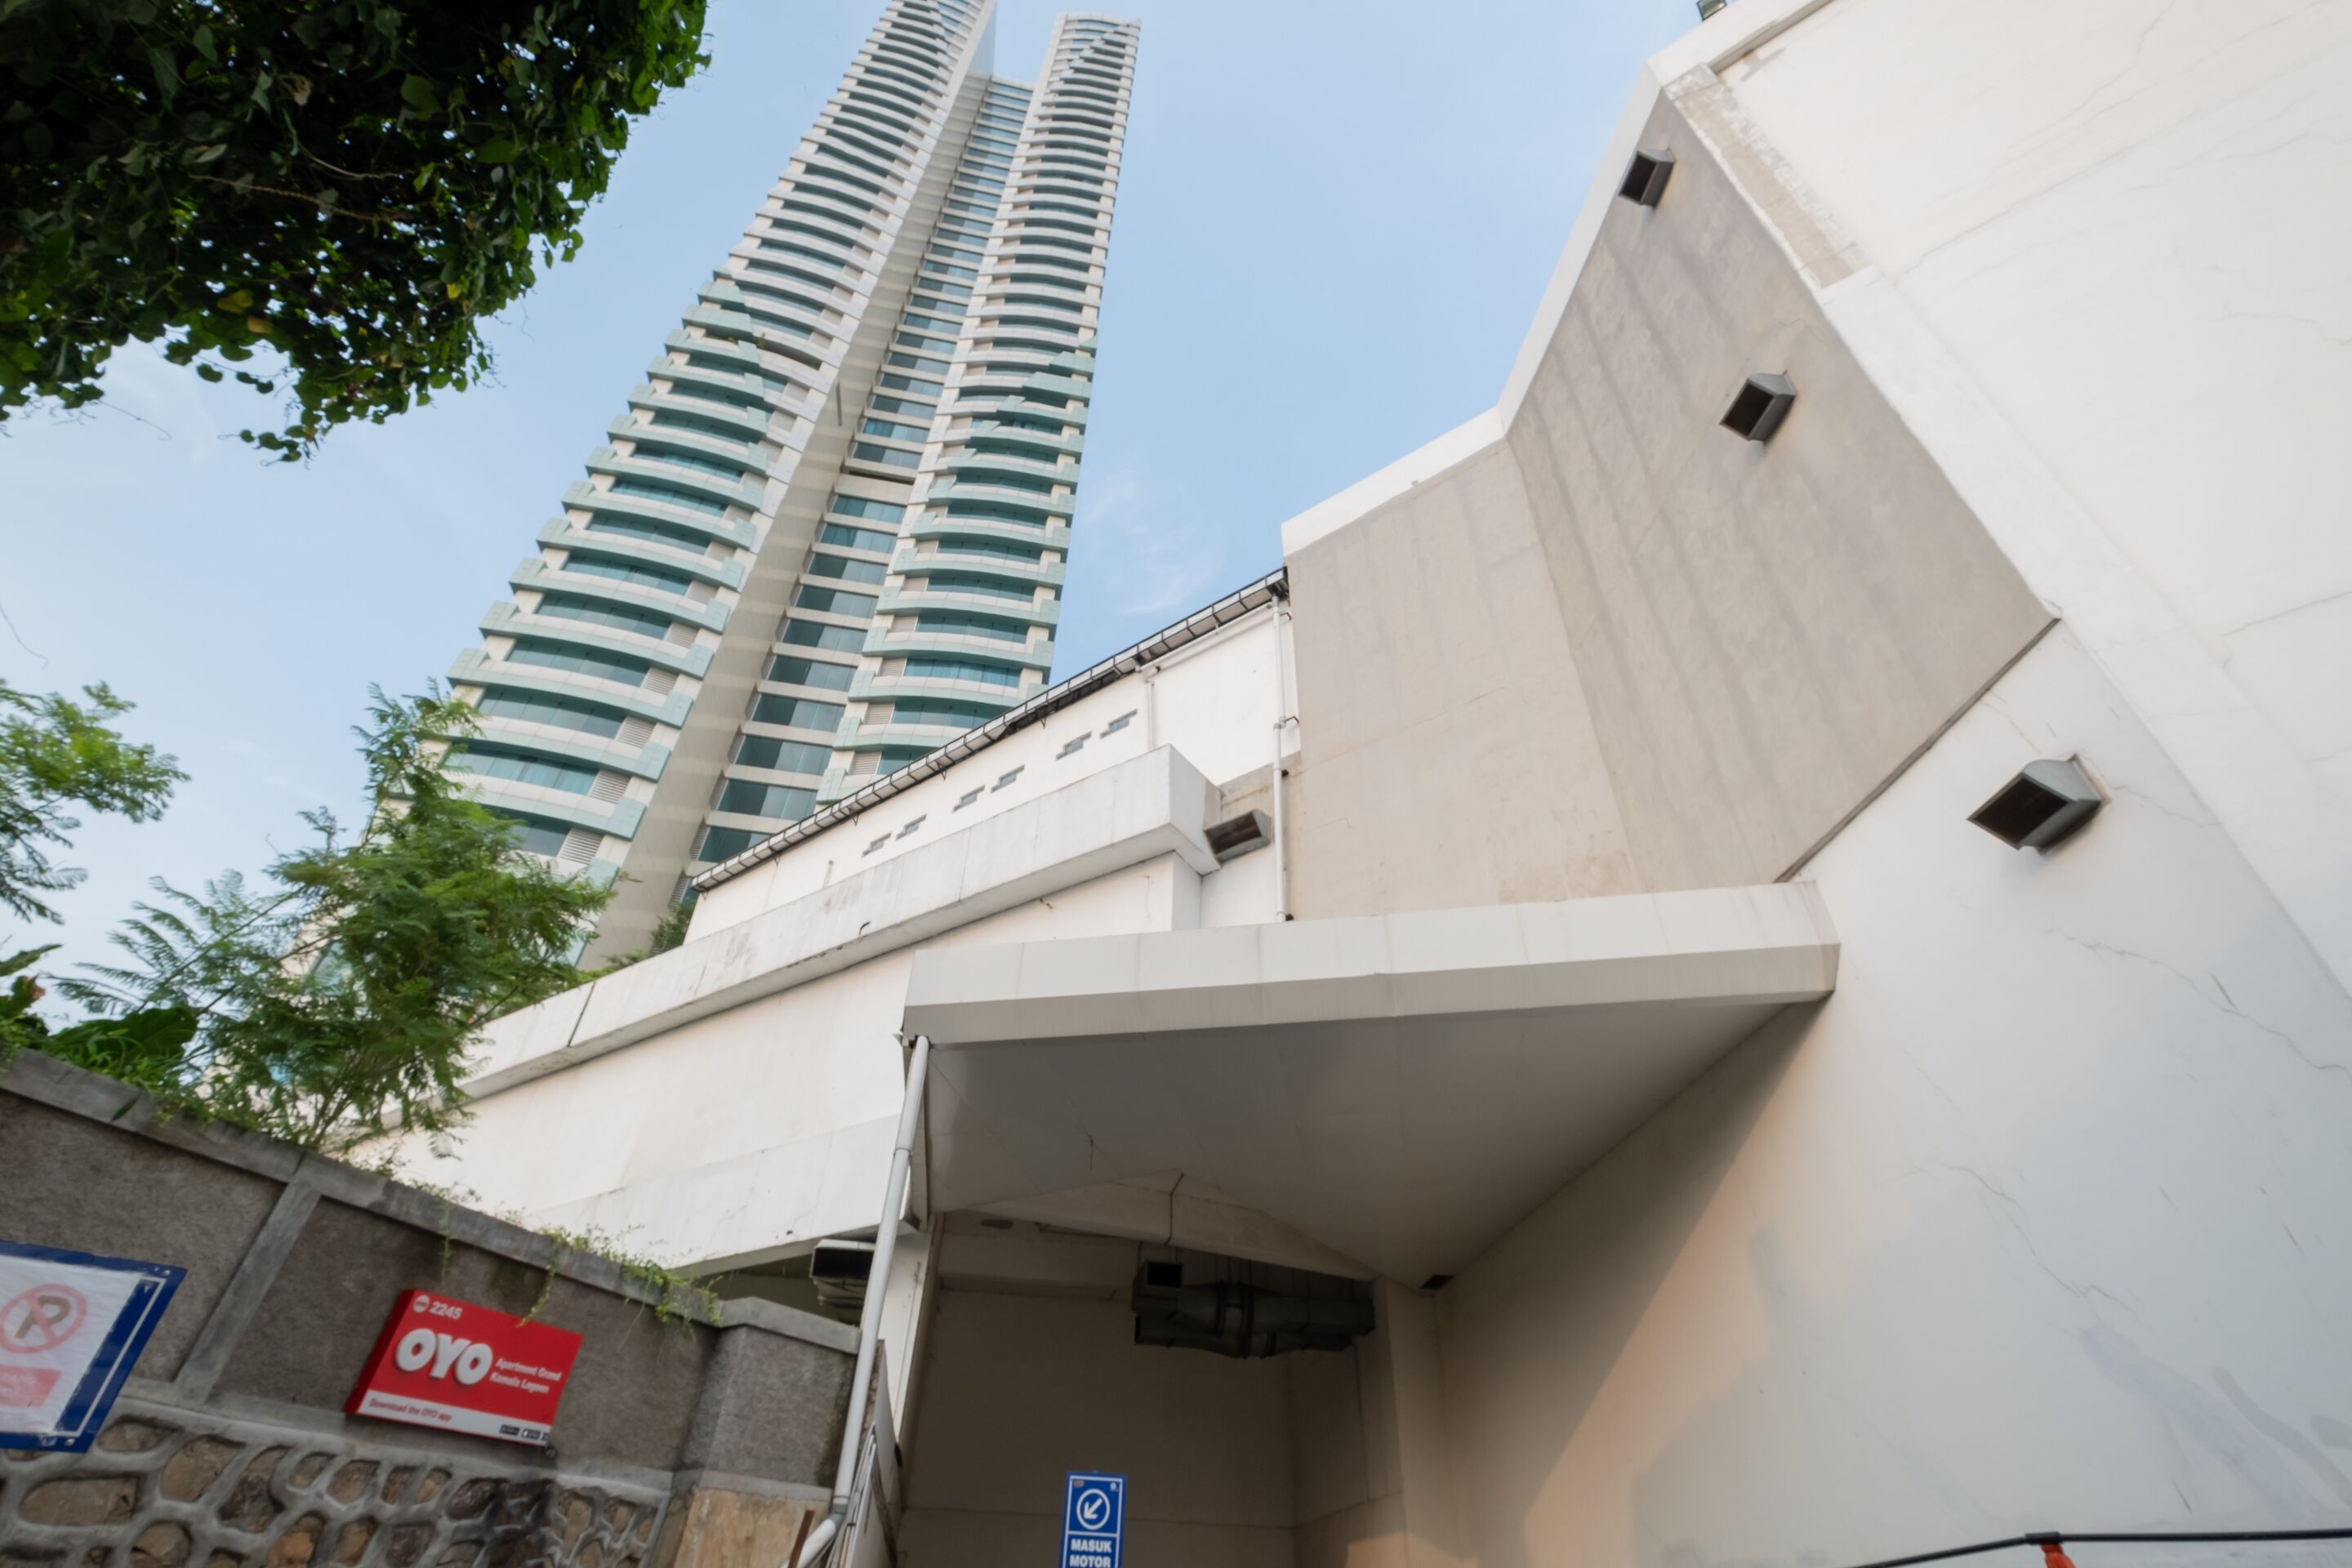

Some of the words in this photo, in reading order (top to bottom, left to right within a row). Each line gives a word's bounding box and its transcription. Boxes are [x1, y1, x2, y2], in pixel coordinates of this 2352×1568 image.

[429, 1301, 463, 1320] 2245
[396, 1328, 493, 1385] OYO
[495, 1357, 539, 1376] Apartment
[537, 1366, 562, 1382] Grand
[368, 1397, 408, 1414] Download
[1071, 1538, 1112, 1553] MASUK
[1069, 1554, 1111, 1568] MOTOR
